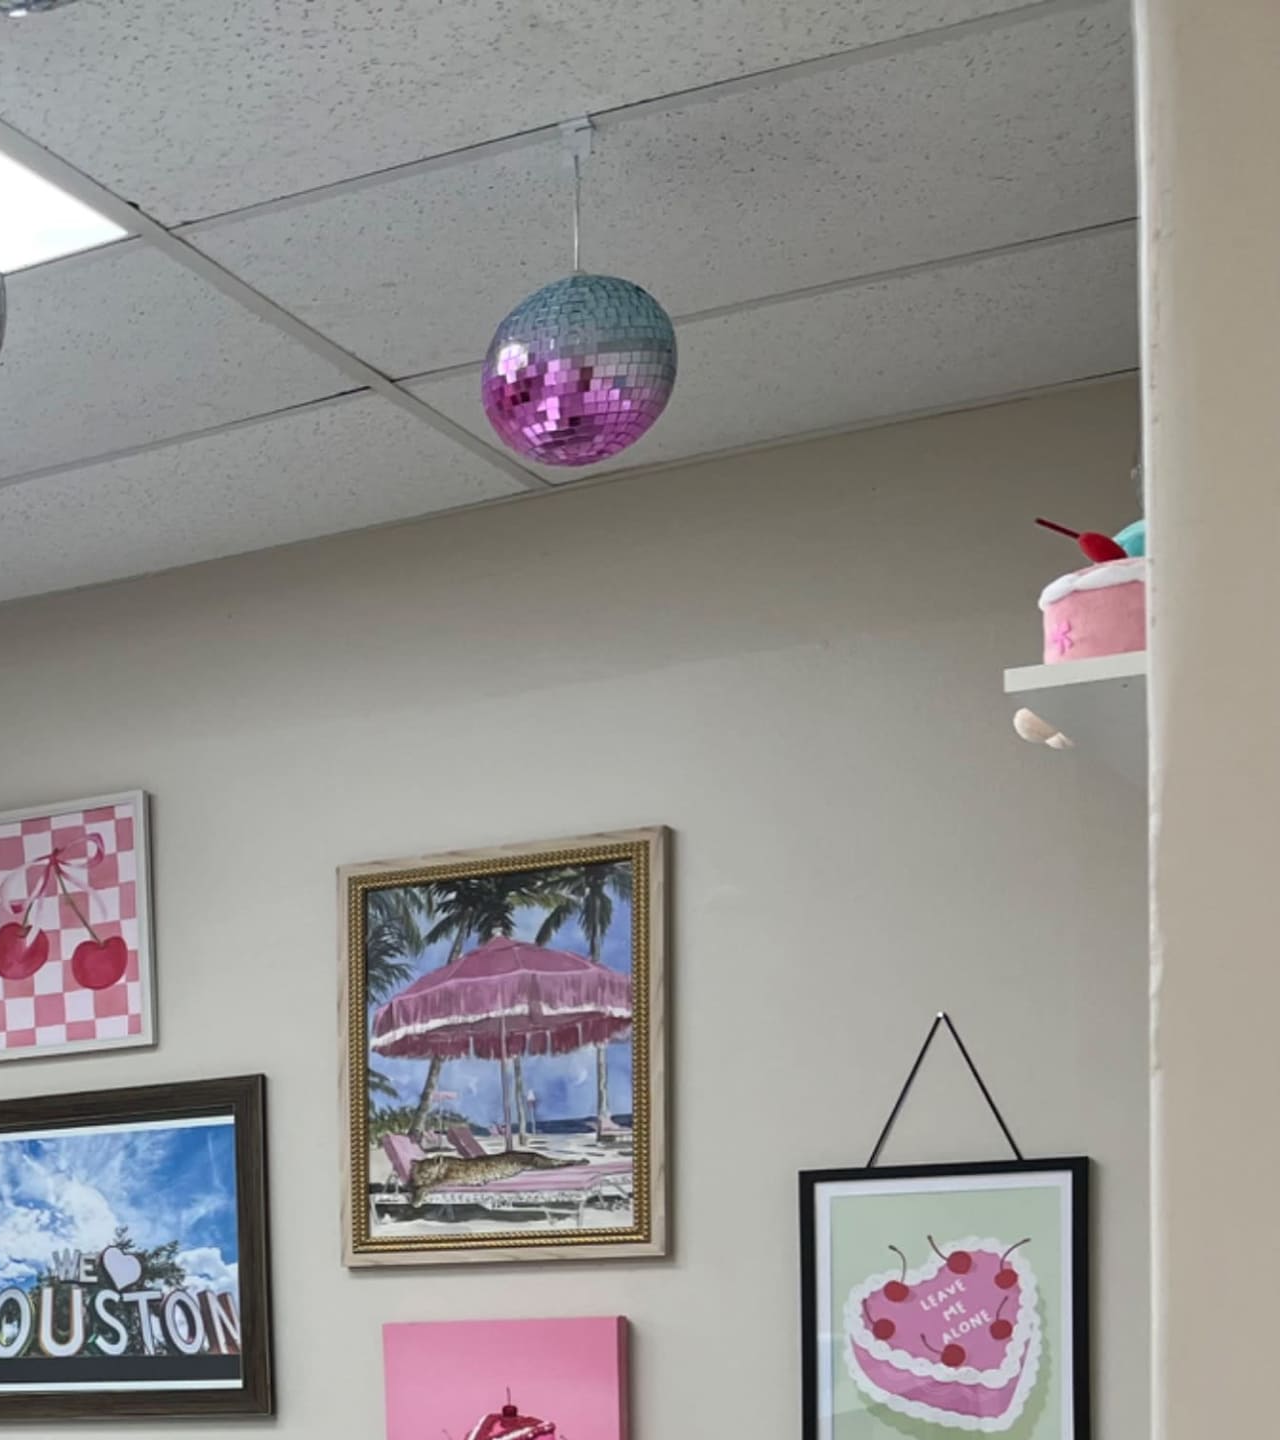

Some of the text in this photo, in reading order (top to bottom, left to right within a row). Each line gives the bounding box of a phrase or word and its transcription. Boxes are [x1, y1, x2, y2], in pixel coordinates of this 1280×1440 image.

[52, 1247, 98, 1283] WE
[920, 1280, 966, 1311] LEAVE
[943, 1301, 966, 1321] ME
[943, 1310, 991, 1344] ALONE
